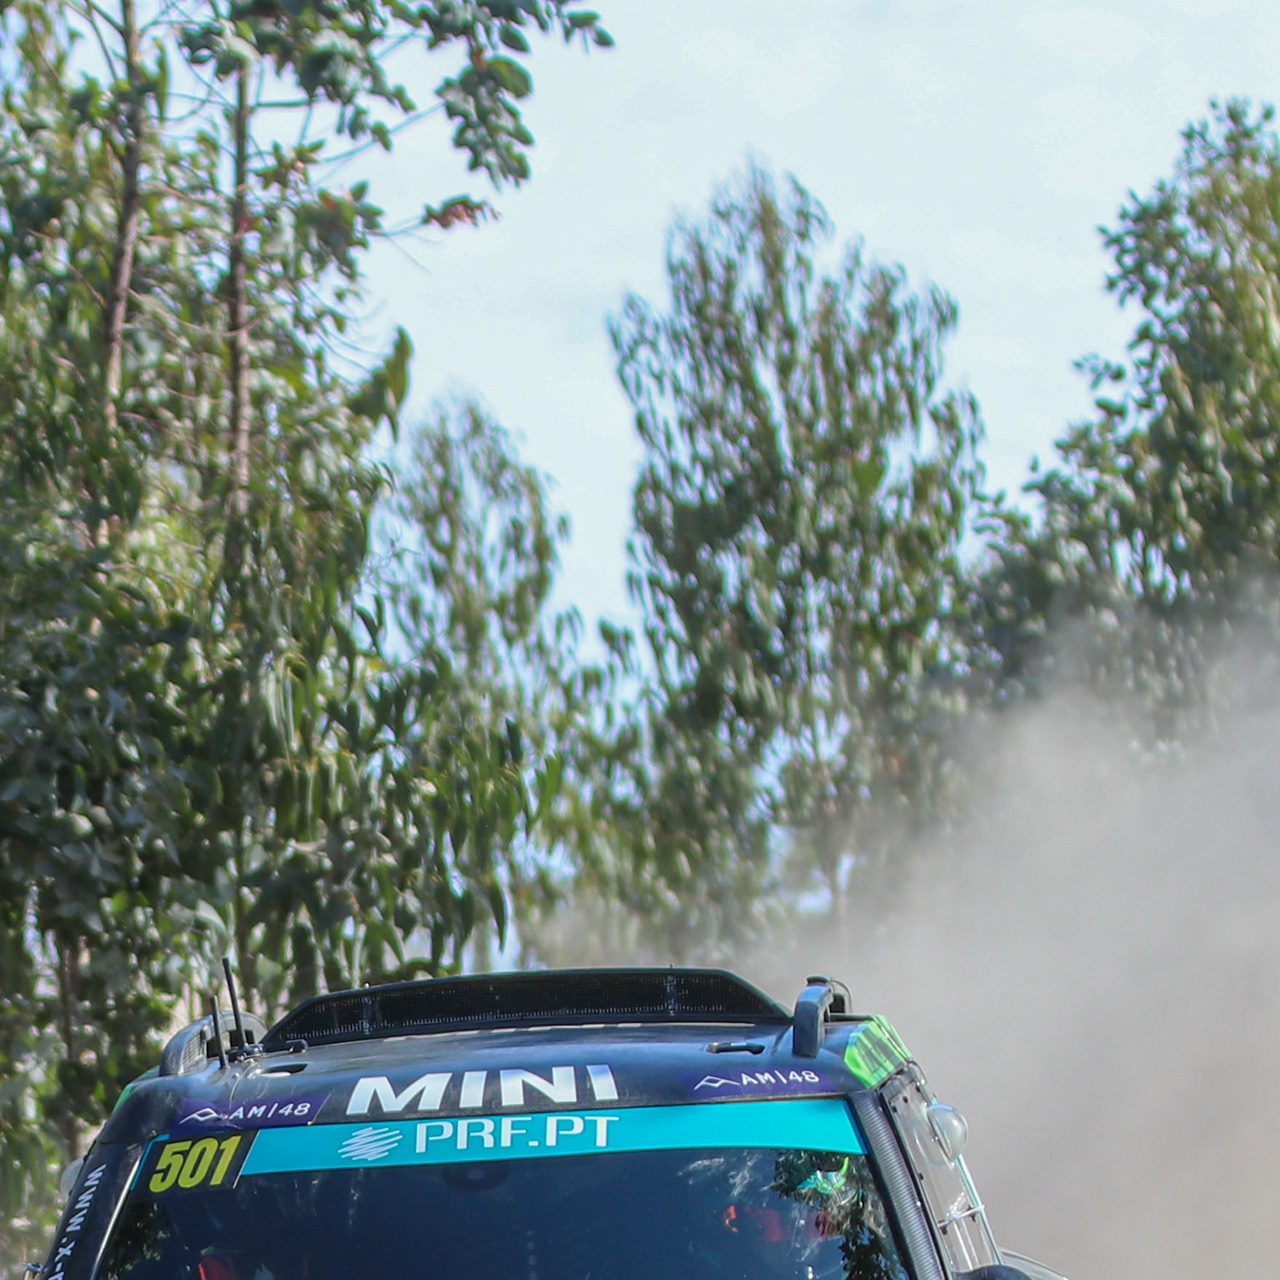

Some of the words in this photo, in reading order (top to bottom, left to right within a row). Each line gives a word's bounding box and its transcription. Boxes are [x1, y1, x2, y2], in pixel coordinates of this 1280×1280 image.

[346, 1064, 619, 1116] MINI
[416, 1115, 620, 1153] PRF.PT
[149, 1135, 242, 1193] 501
